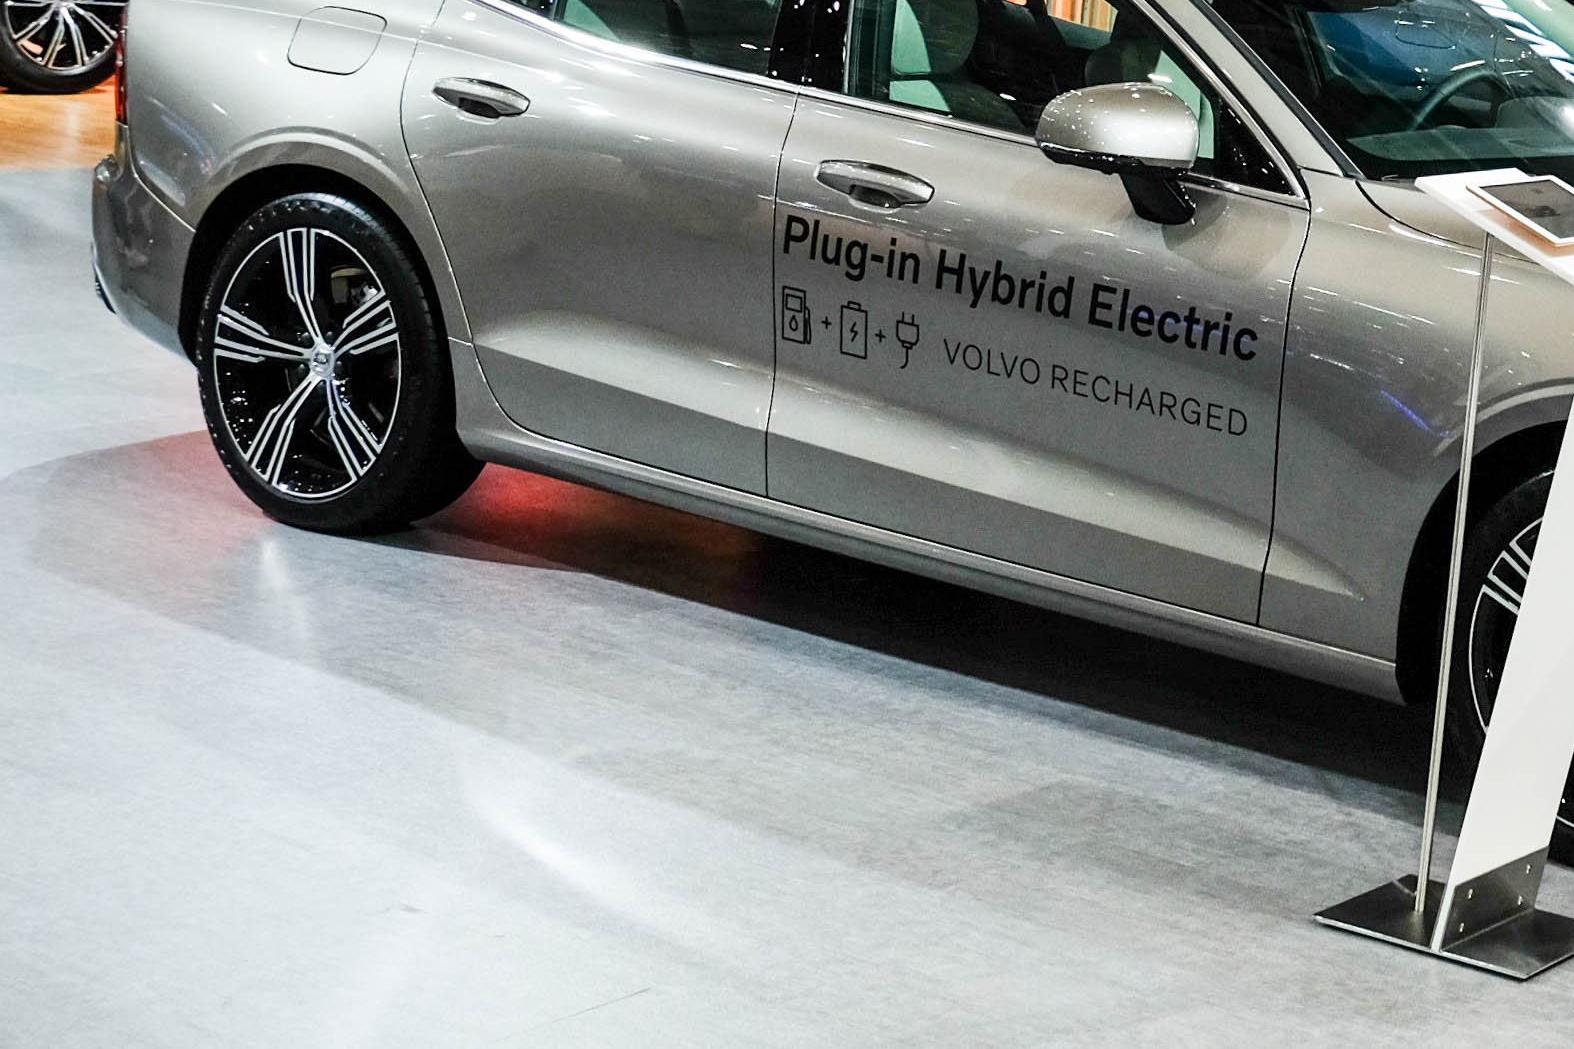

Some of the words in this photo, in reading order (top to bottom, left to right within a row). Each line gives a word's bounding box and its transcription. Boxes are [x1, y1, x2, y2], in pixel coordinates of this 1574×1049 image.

[783, 214, 921, 285] Plug-in
[935, 247, 1076, 320] Hybrid
[1088, 284, 1258, 362] Electric
[942, 337, 1041, 387] VOLVO
[1051, 365, 1249, 438] RECHARGED
